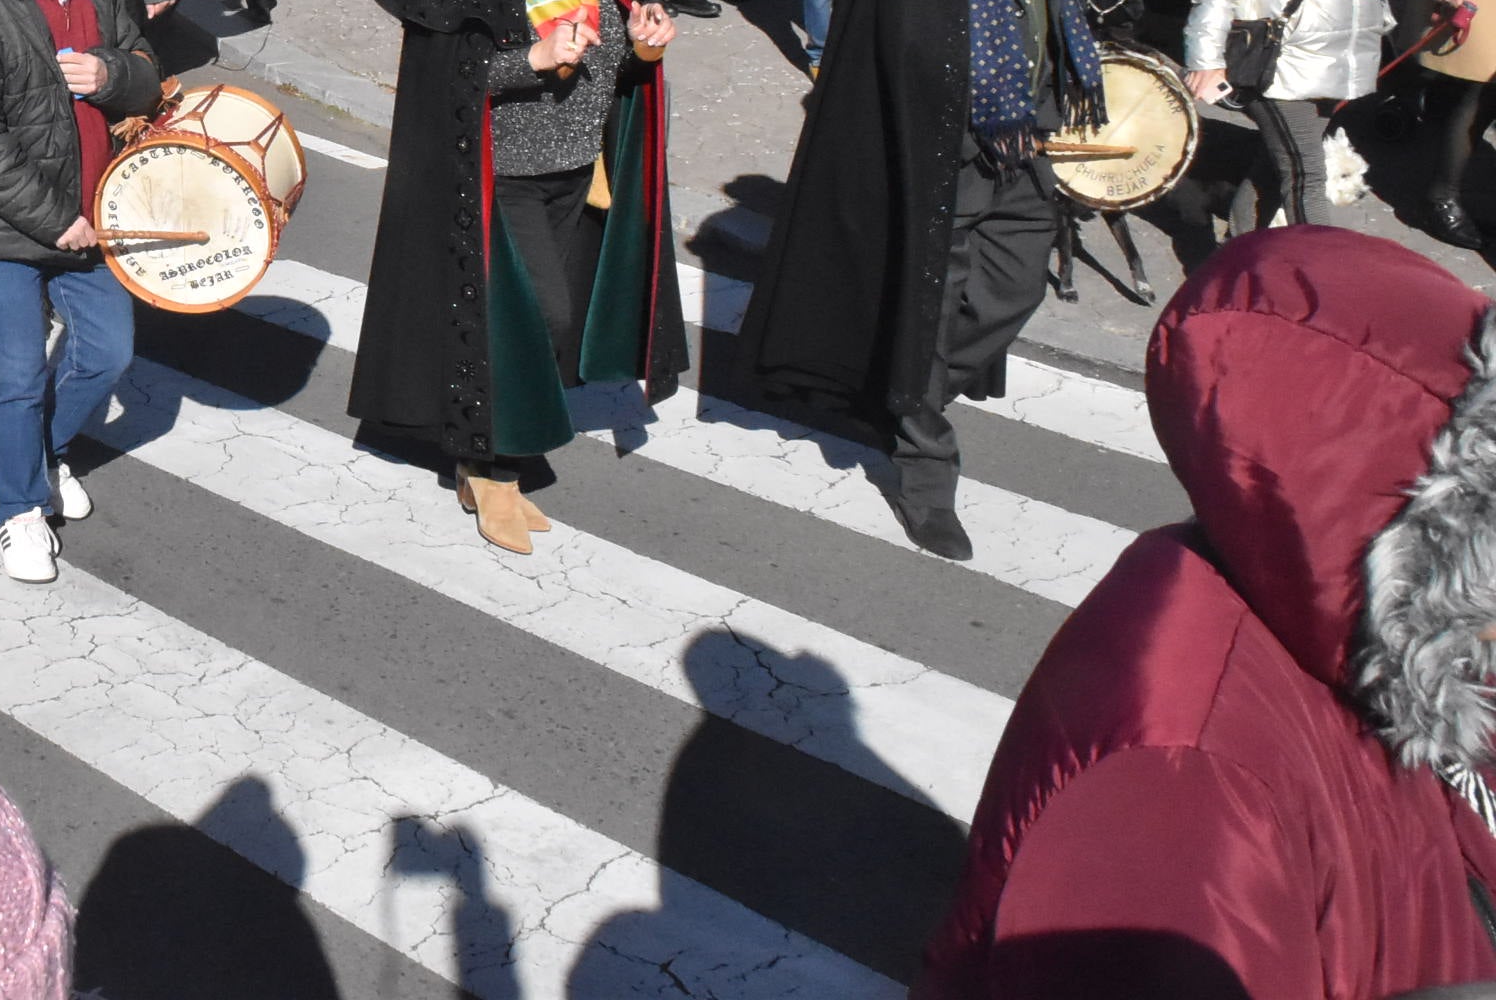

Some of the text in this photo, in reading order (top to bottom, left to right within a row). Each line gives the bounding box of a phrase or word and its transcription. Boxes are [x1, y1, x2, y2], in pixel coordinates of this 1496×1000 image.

[121, 147, 187, 179] CASTRO
[208, 157, 264, 229] BORREGO
[1106, 177, 1149, 197] BEJAR
[158, 246, 253, 280] ASPROCOLOR
[189, 271, 234, 289] BEJAR
